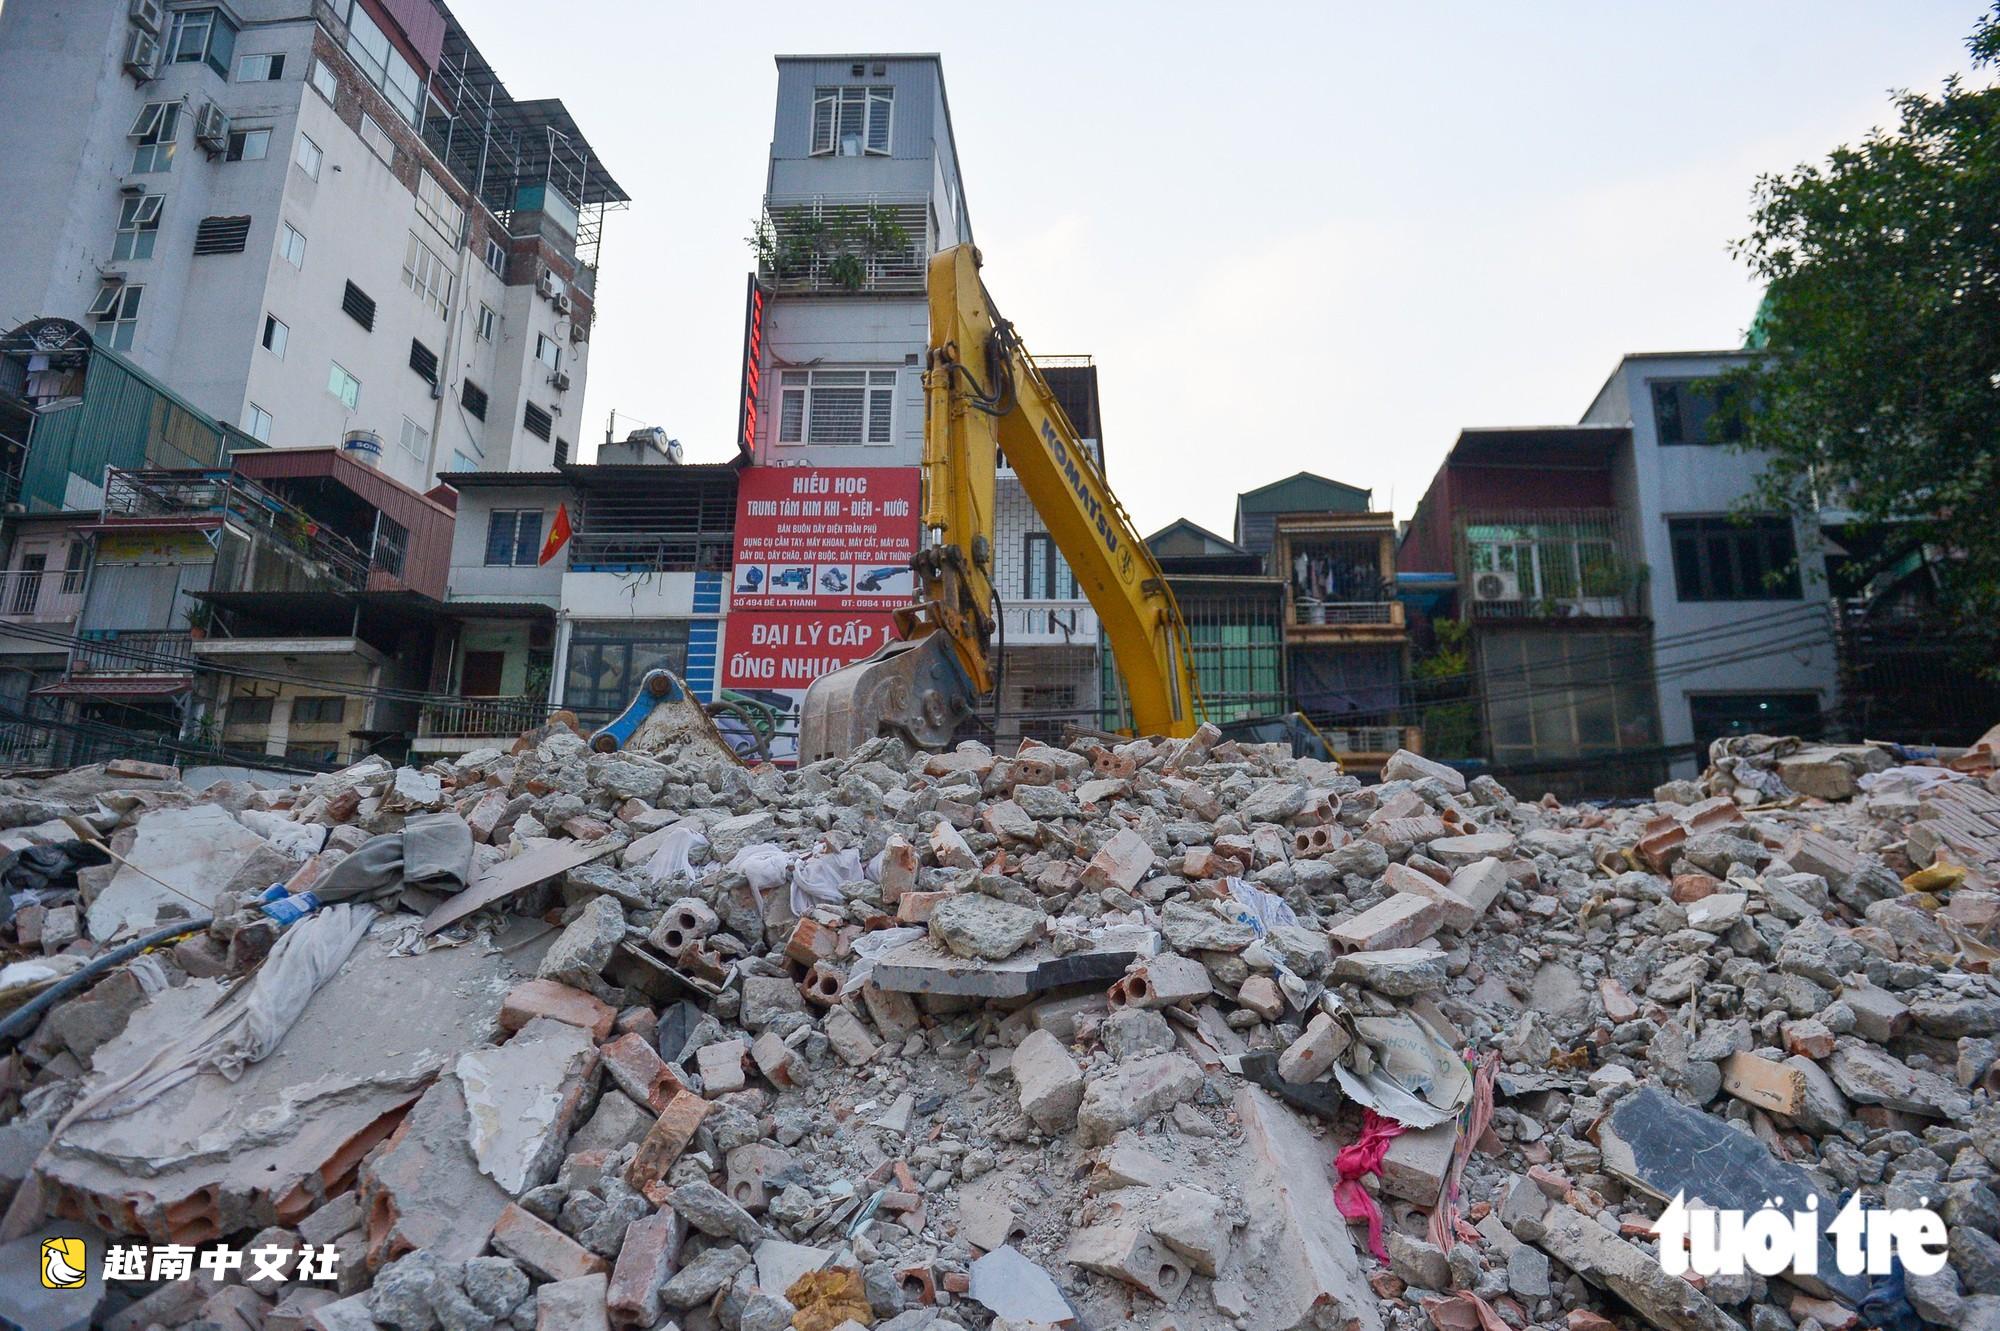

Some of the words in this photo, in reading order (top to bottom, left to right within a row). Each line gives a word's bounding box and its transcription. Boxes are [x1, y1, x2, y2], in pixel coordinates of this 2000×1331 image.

[793, 471, 830, 494] HIẾU
[834, 477, 868, 497] HỌC
[1041, 417, 1117, 553] KOMATSU
[747, 500, 777, 517] TRUNG
[780, 498, 800, 517] TÂM
[802, 500, 821, 517] KIM
[850, 498, 873, 519] ĐIỆN
[883, 497, 909, 517] NƯỚC
[777, 523, 792, 534] BÁN
[793, 523, 811, 534] BUÔN
[844, 522, 863, 534] TRẦN
[806, 537, 821, 547] MÁY
[848, 537, 863, 547] MÁY
[880, 537, 895, 547] MÁY
[896, 537, 910, 547] CƯA
[777, 599, 788, 607] LA
[751, 624, 789, 649] ĐẠI
[794, 620, 823, 646] LÝ
[828, 619, 872, 646] CẤP
[880, 625, 890, 646] 1
[730, 651, 775, 678] ỐNG
